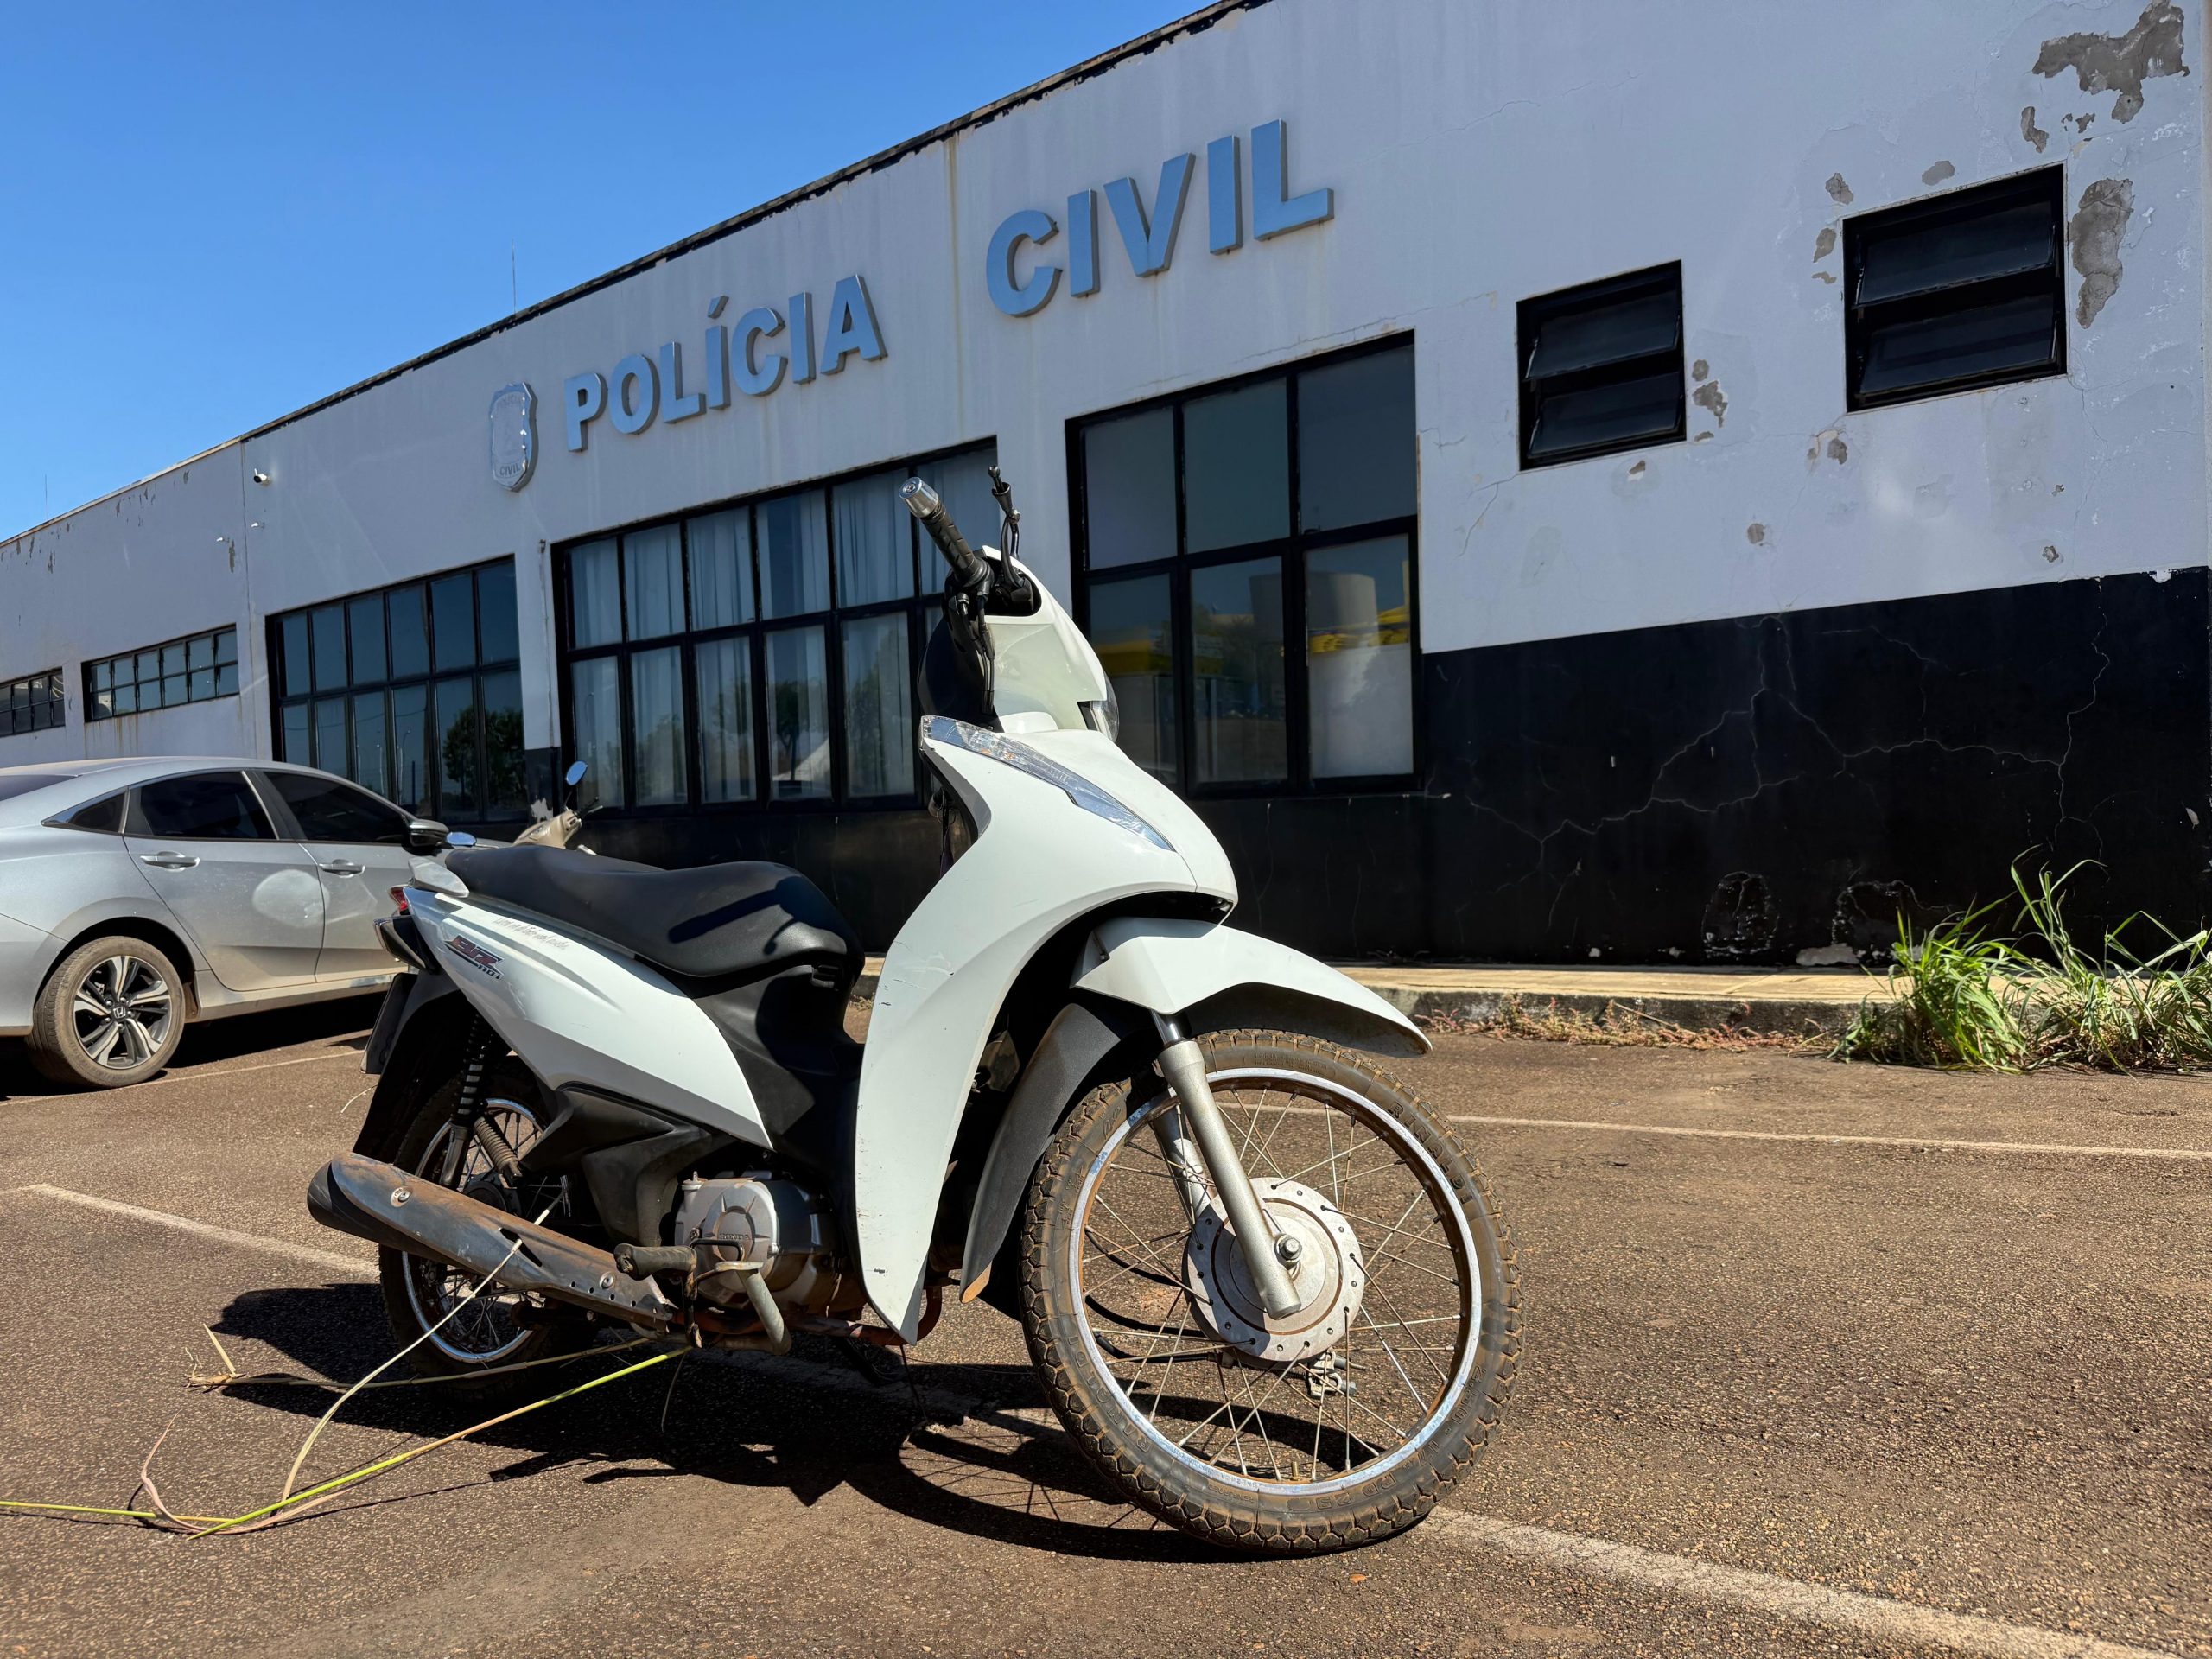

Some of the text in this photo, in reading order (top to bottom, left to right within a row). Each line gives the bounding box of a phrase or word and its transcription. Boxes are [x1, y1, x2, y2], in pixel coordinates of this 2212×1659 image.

[564, 118, 1334, 452] POLÍCIA CIVIL
[499, 463, 521, 477] CIVIL
[1387, 1102, 1473, 1205] RINALDI
[1069, 1336, 1151, 1453] RINALDI
